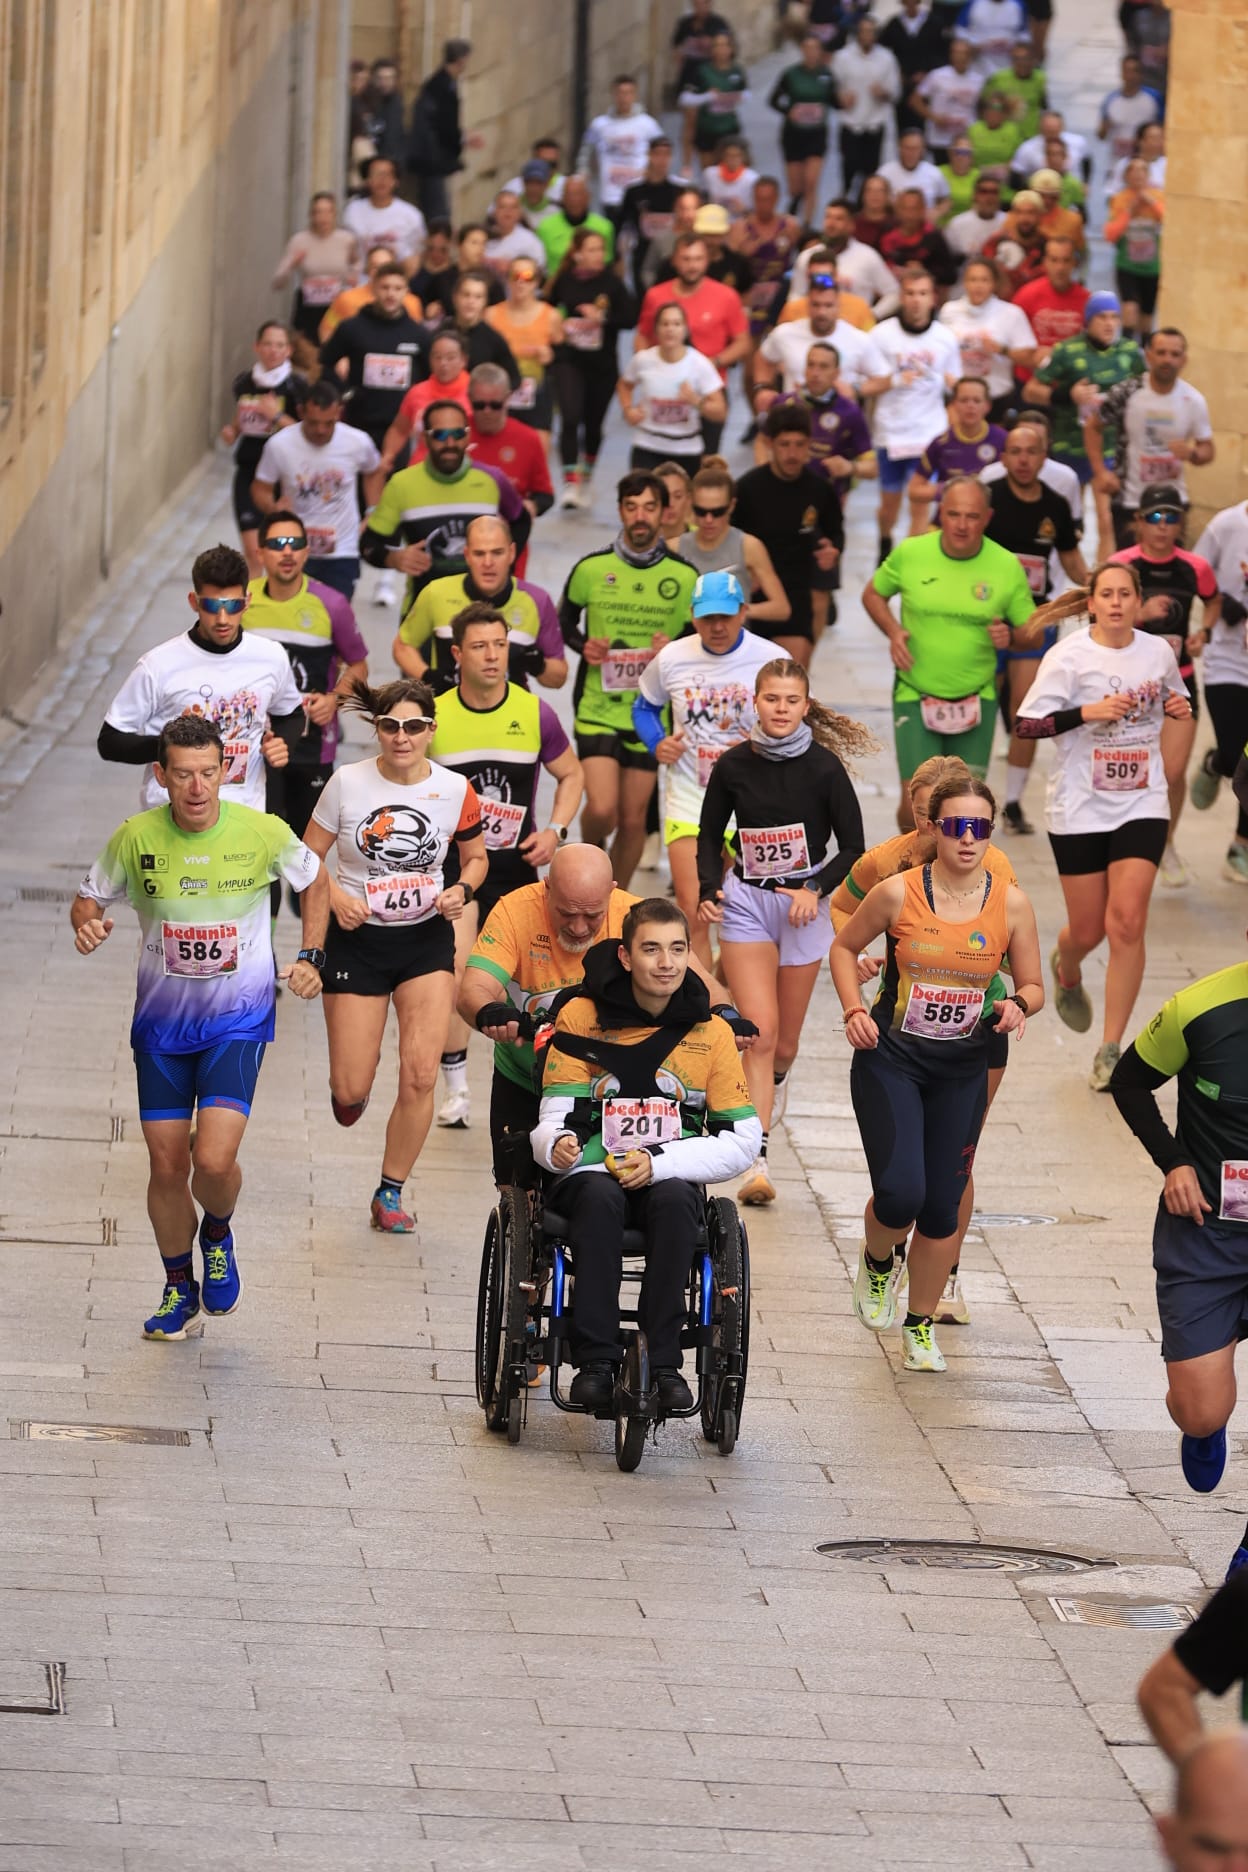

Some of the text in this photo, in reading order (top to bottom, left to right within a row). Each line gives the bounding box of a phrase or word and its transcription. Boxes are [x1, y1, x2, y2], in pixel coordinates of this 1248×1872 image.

[936, 705, 965, 721] 611
[1094, 749, 1149, 761] bedunia
[1106, 762, 1139, 779] 509
[741, 829, 804, 844] bedunia
[184, 854, 211, 865] vive
[754, 842, 792, 862] 325
[181, 881, 208, 889] ARIAS
[366, 875, 435, 895] bedunia
[384, 889, 422, 911] 461
[163, 924, 238, 940] bedunia
[178, 941, 222, 961] 586
[912, 984, 984, 1005] bedunia
[924, 1002, 967, 1024] 585
[604, 1103, 678, 1118] bedunia
[619, 1116, 663, 1137] 201
